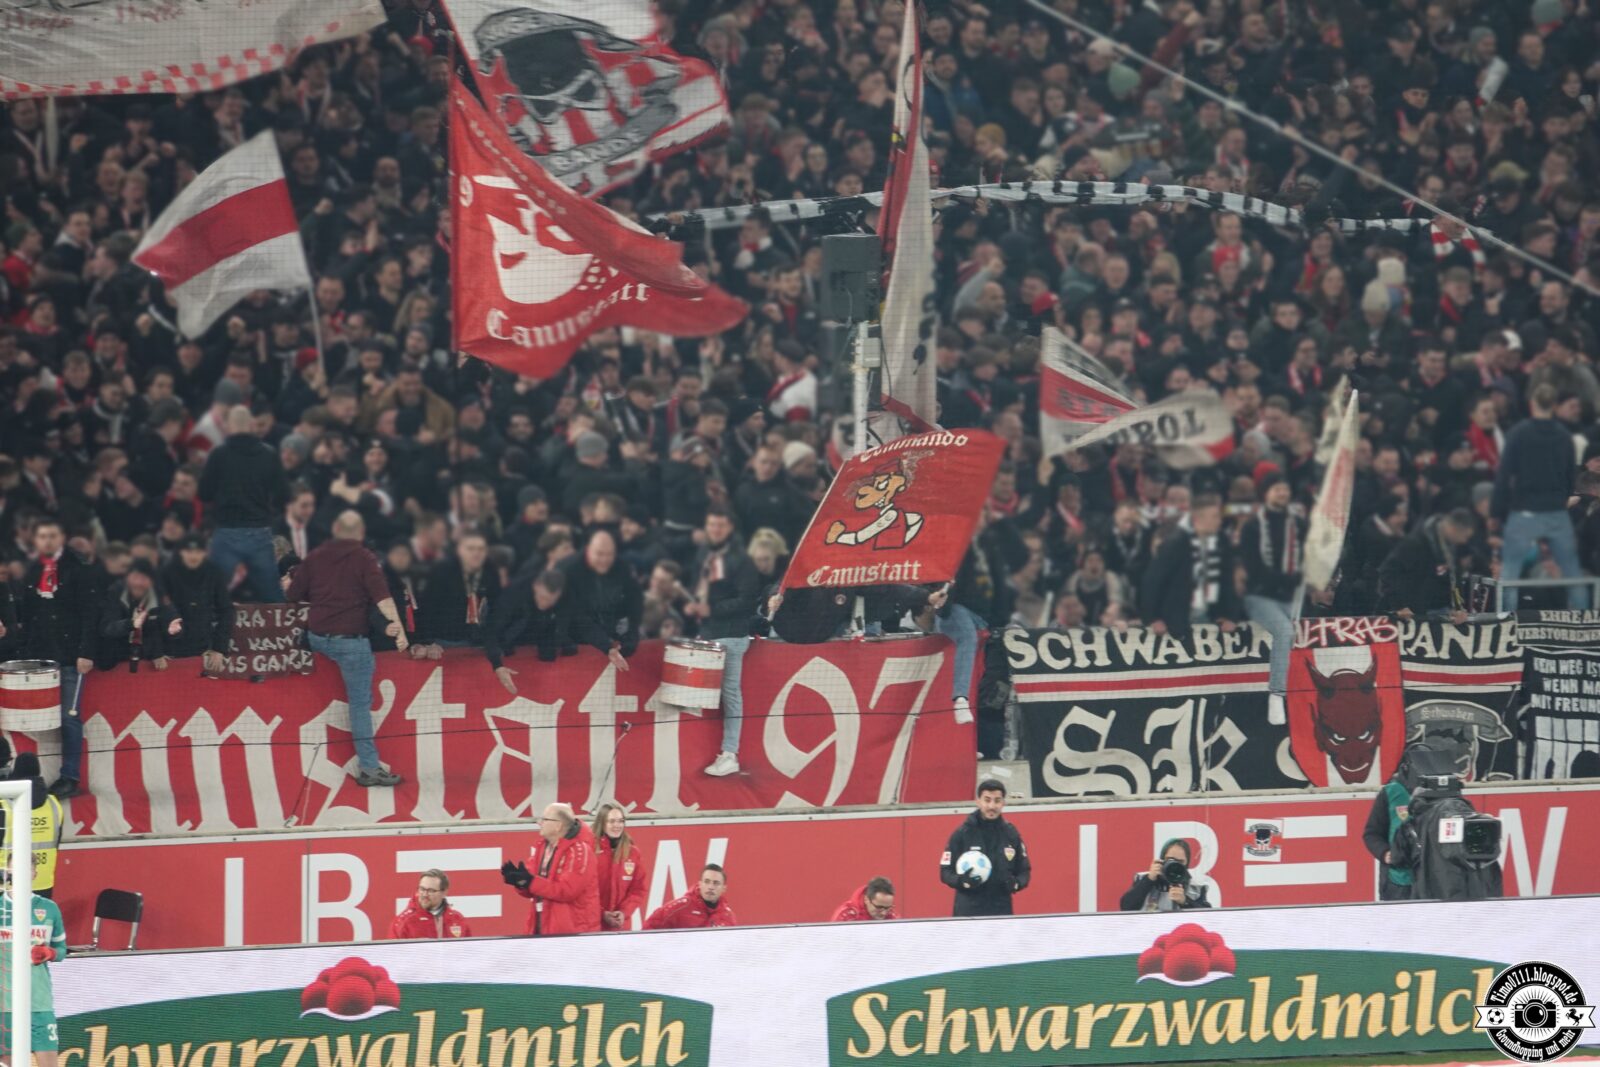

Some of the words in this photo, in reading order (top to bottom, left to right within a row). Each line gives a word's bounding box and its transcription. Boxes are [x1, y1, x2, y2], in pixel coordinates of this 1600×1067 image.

[860, 432, 968, 463] Commando
[807, 560, 922, 587] Cannstatt
[1003, 621, 1273, 670] SCHWABEN
[1396, 614, 1525, 660] PANIE
[12, 662, 698, 837] nnstatt
[763, 652, 945, 808] 97
[46, 1001, 690, 1067] chwarzwaldmilch
